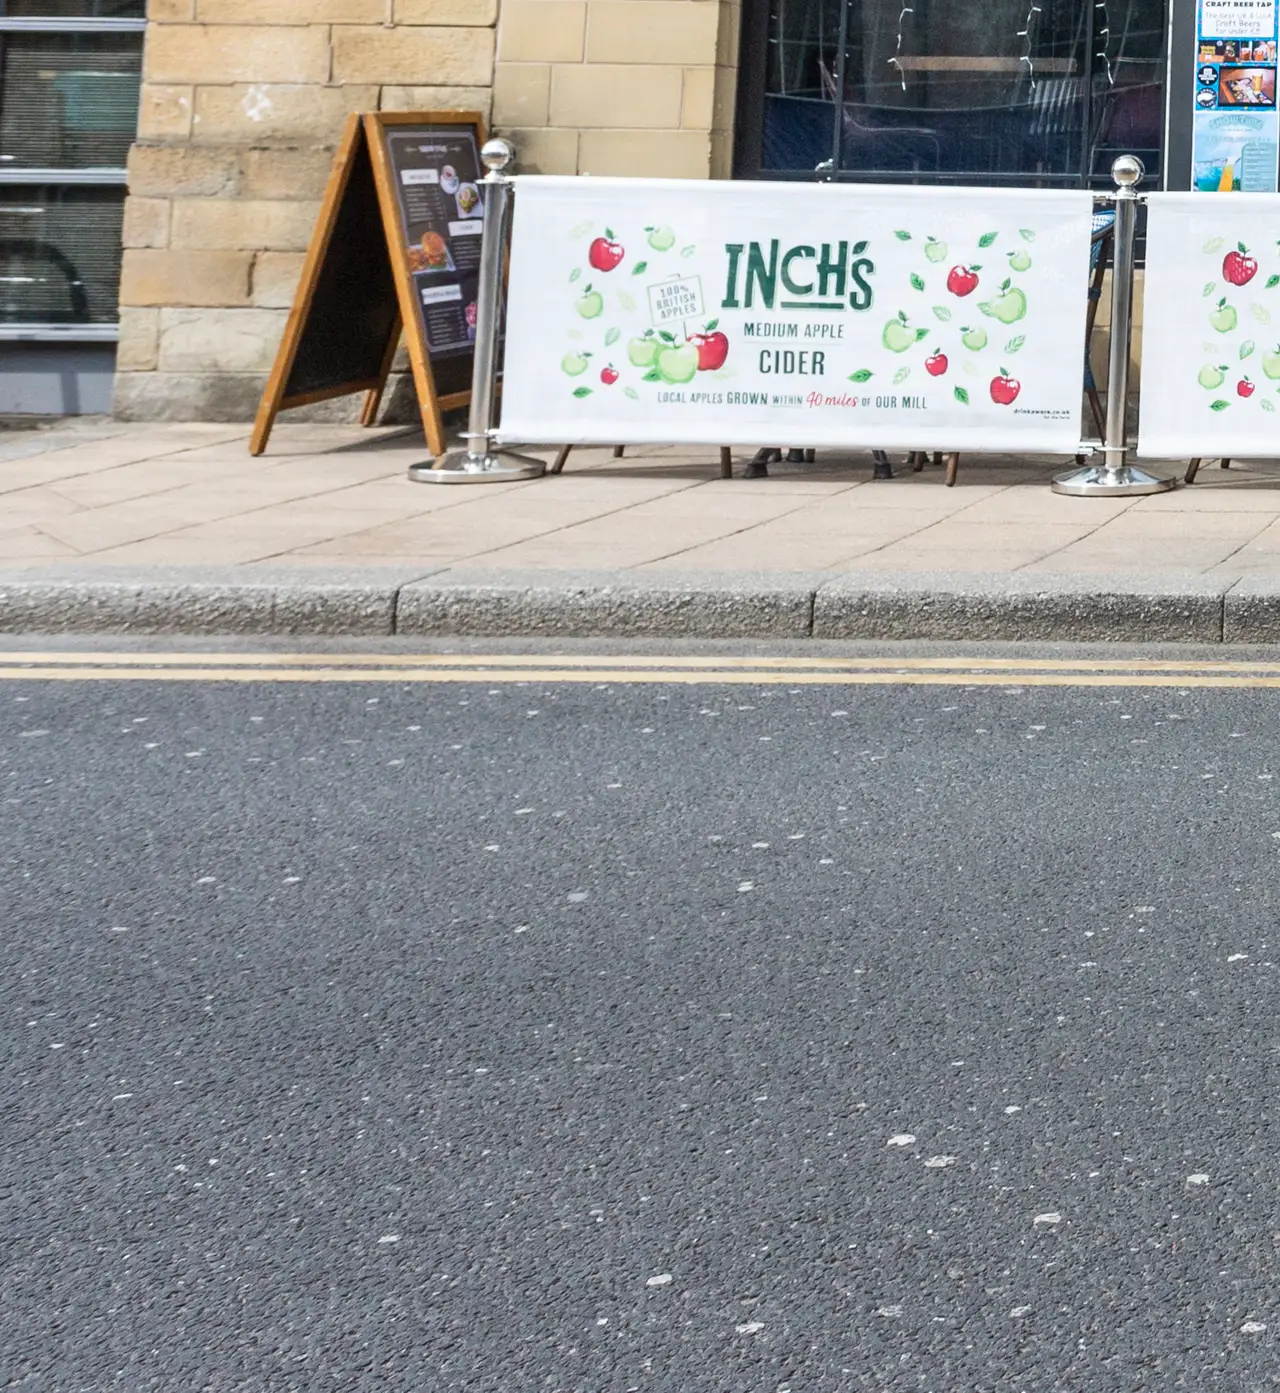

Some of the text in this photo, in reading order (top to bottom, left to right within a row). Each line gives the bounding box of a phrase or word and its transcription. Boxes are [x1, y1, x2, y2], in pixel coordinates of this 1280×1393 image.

[660, 285, 689, 298] 100%
[656, 294, 696, 309] BRITISH
[660, 305, 697, 319] APPLES
[744, 322, 844, 339] MEDIUM APPLE
[759, 350, 825, 375] CIDER
[657, 391, 928, 409] LOCAL APPLES GROWN WITHIN 40 miles OF OUR MILL
